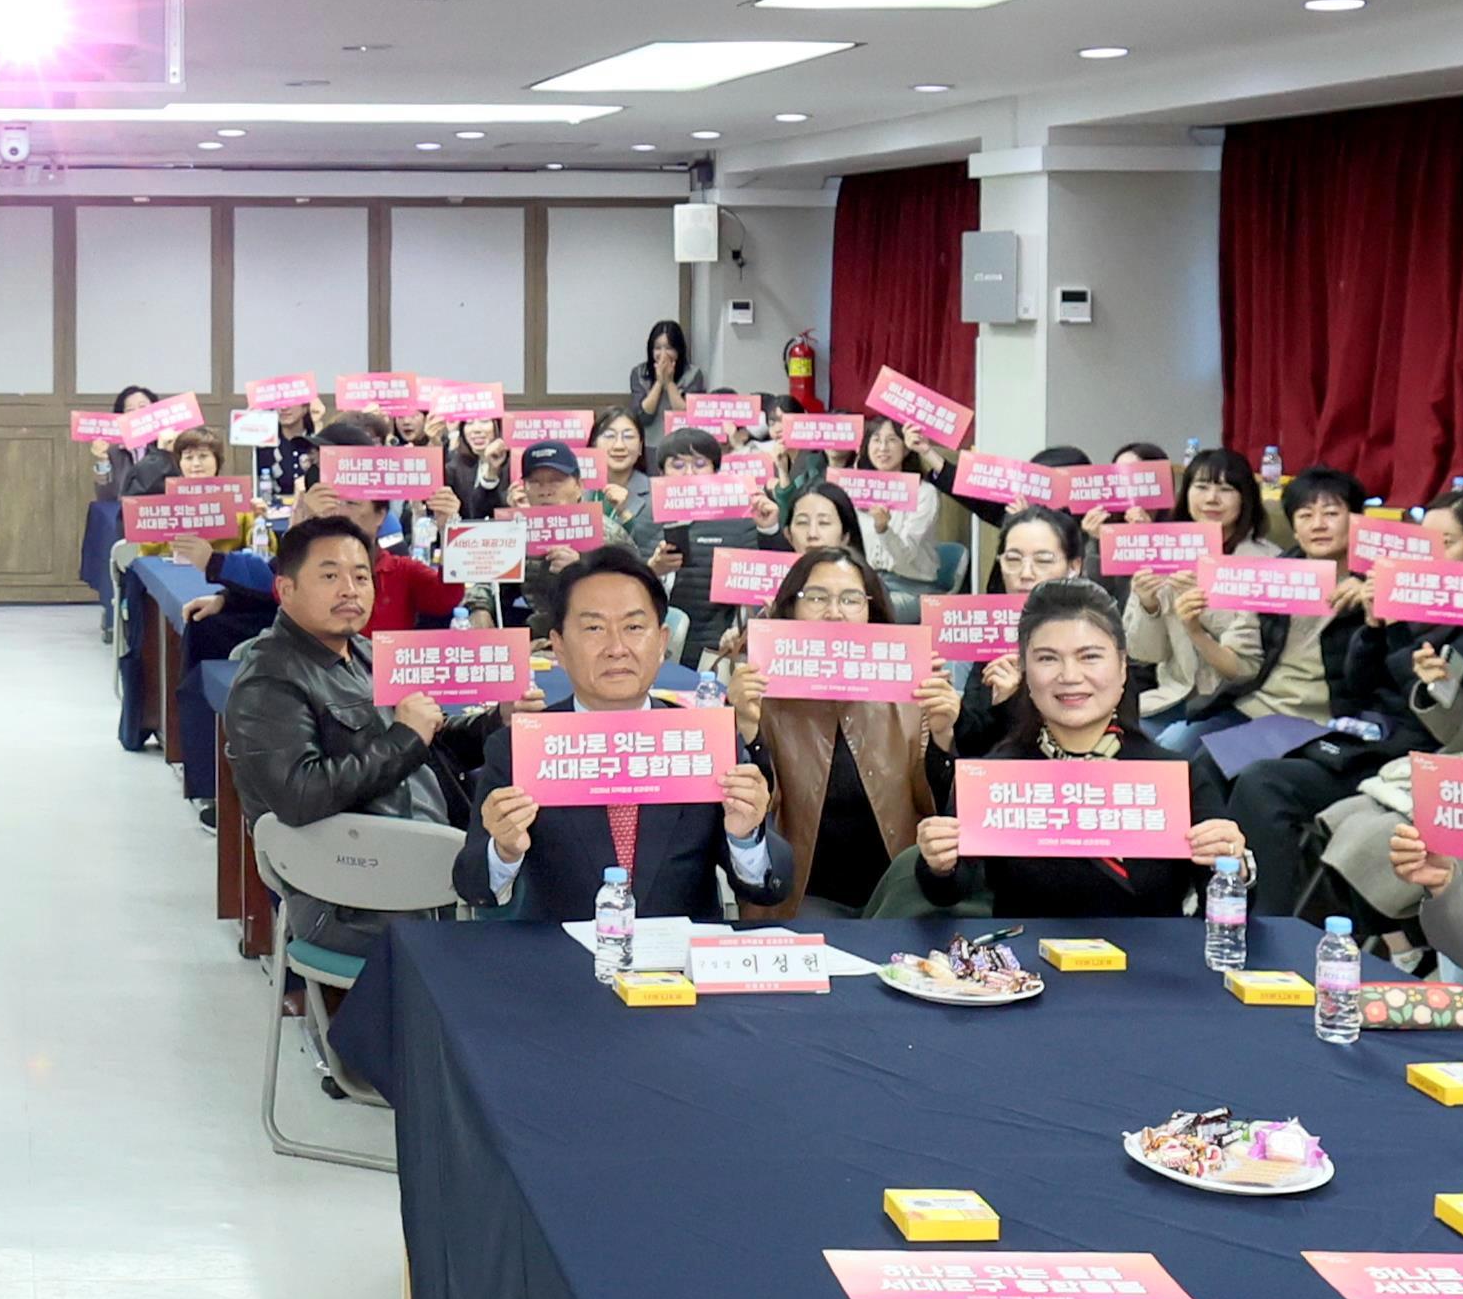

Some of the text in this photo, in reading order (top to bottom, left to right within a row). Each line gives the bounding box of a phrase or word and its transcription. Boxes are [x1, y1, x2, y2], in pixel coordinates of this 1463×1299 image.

[338, 458, 374, 471] 하나로
[376, 458, 400, 471] 잇는
[334, 472, 381, 485] 서대문구
[942, 611, 988, 626] 하나로
[939, 628, 999, 644] 서대문구
[395, 647, 441, 665] 하나로
[444, 646, 474, 664] 잇는
[774, 637, 827, 657] 하나로
[831, 640, 866, 659] 잇는
[390, 665, 450, 684] 서대문구
[768, 657, 839, 678] 서대문구
[545, 730, 703, 756] 하나로 잇는 돌봄
[537, 753, 711, 780] 서대문구 통합돌봄
[990, 782, 1155, 805] 하나로 잇는 돌봄
[982, 806, 1164, 830] 서대문구 통합돌봄
